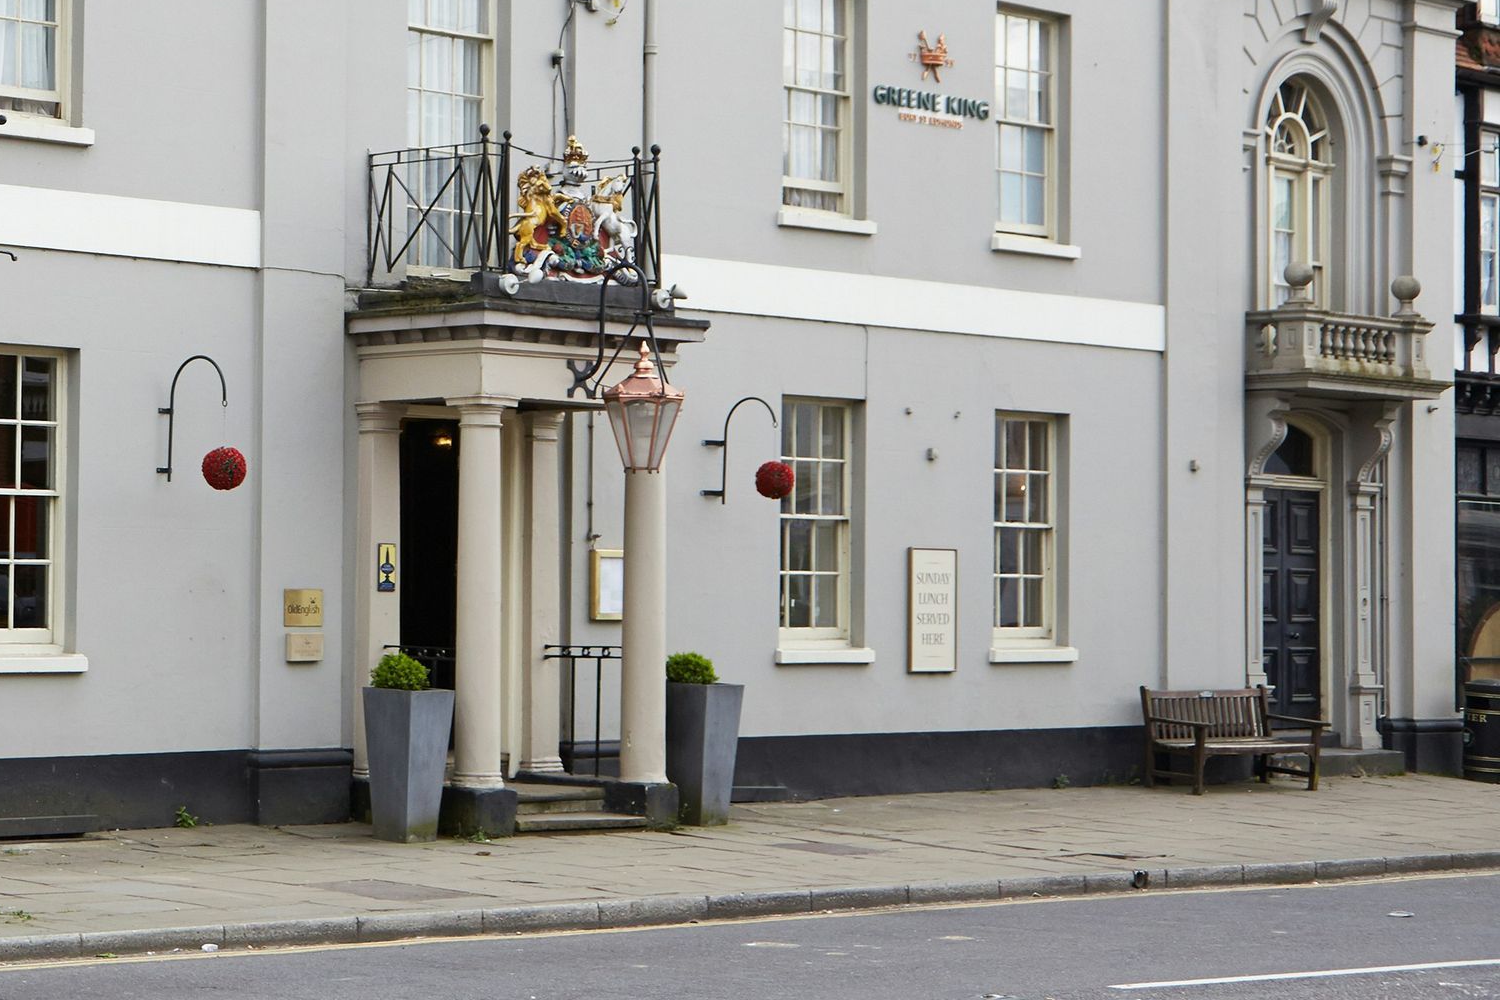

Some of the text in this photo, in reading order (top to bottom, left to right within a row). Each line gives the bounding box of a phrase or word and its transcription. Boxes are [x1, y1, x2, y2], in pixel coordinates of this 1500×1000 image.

[873, 85, 990, 121] GREENE KING
[916, 572, 951, 585] SUNDAY
[918, 592, 948, 605] LUNCH
[916, 613, 950, 625] SERVED
[921, 633, 945, 645] HERE
